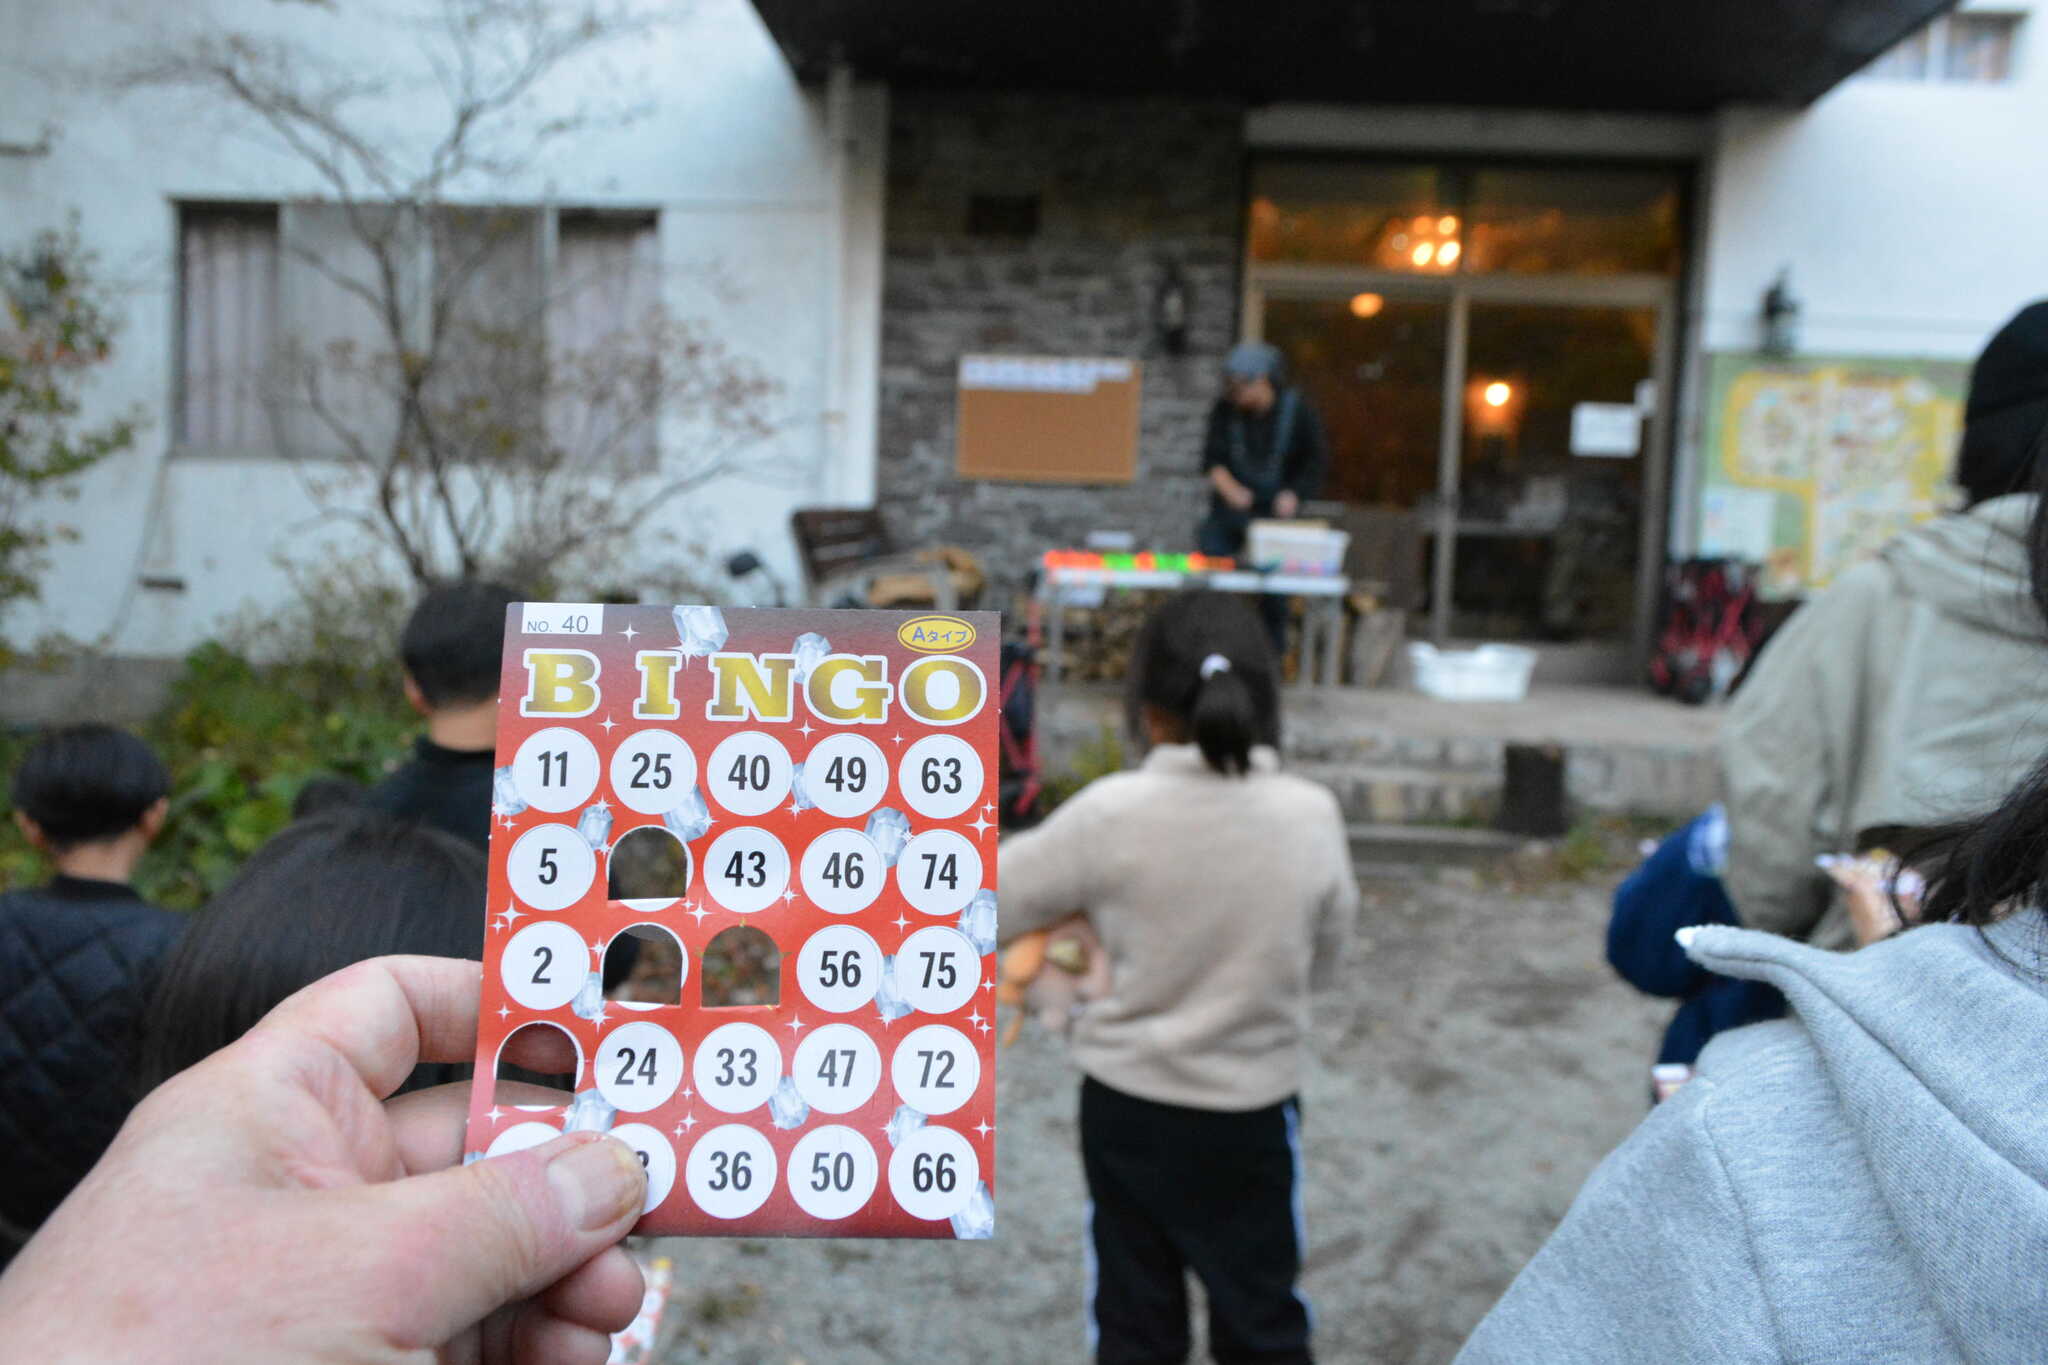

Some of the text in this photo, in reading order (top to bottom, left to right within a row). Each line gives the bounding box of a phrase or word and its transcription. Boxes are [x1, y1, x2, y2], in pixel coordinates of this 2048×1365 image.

[527, 615, 589, 633] NO. 40
[521, 649, 986, 726] BINGO
[537, 750, 963, 795] 11 25 40 49 63
[538, 847, 959, 890] 5 43 46 74
[531, 946, 957, 990] 2 56 75
[614, 1047, 955, 1089] 24 33 47 72
[708, 1150, 957, 1193] 36 50 66
